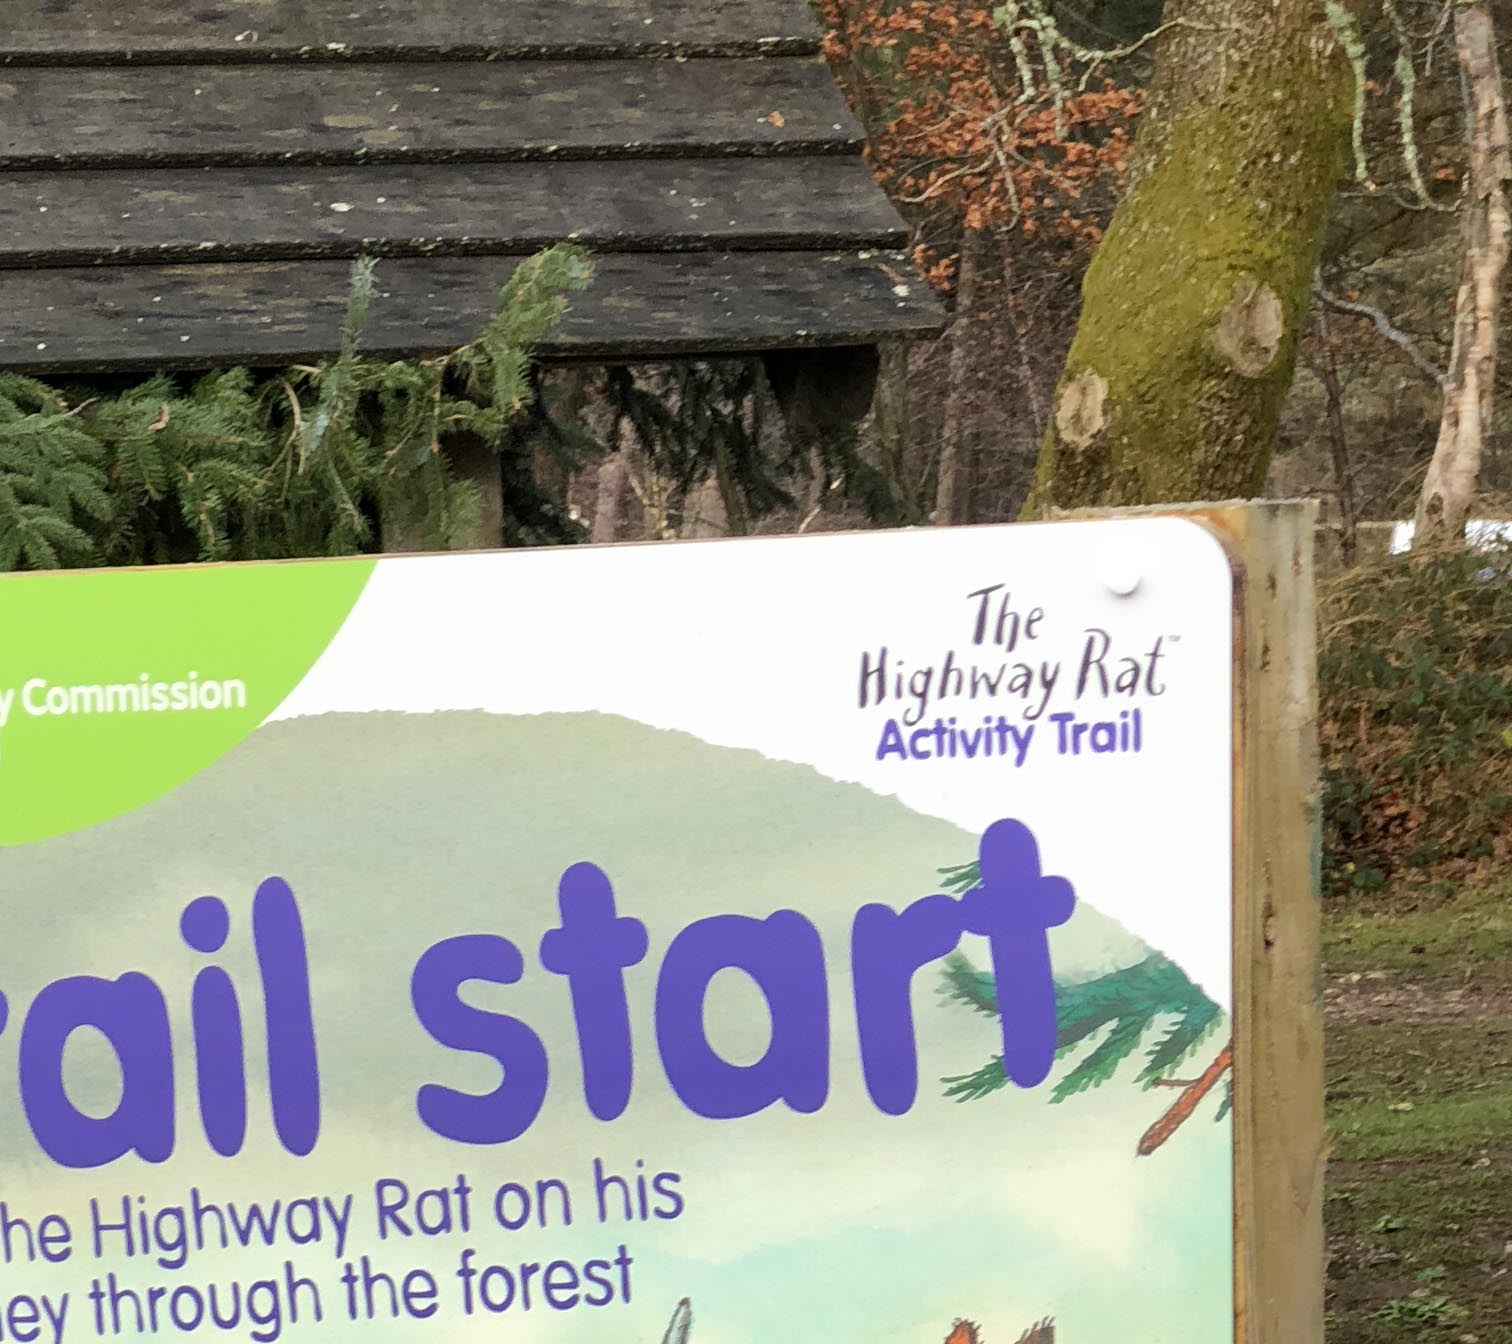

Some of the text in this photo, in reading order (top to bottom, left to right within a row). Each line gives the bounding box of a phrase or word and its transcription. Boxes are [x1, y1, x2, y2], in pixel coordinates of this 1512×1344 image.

[966, 583, 1045, 653] The
[22, 670, 247, 720] Commission
[858, 628, 1167, 727] Highway Rat
[875, 708, 1142, 768] Activity Trail
[410, 817, 1077, 1147] start
[91, 1187, 355, 1271] Highway
[375, 1173, 472, 1239] Rat
[494, 1183, 572, 1231] on
[593, 1158, 685, 1222] his
[88, 1264, 324, 1344] through
[341, 1255, 439, 1322] the
[456, 1244, 634, 1313] forest
